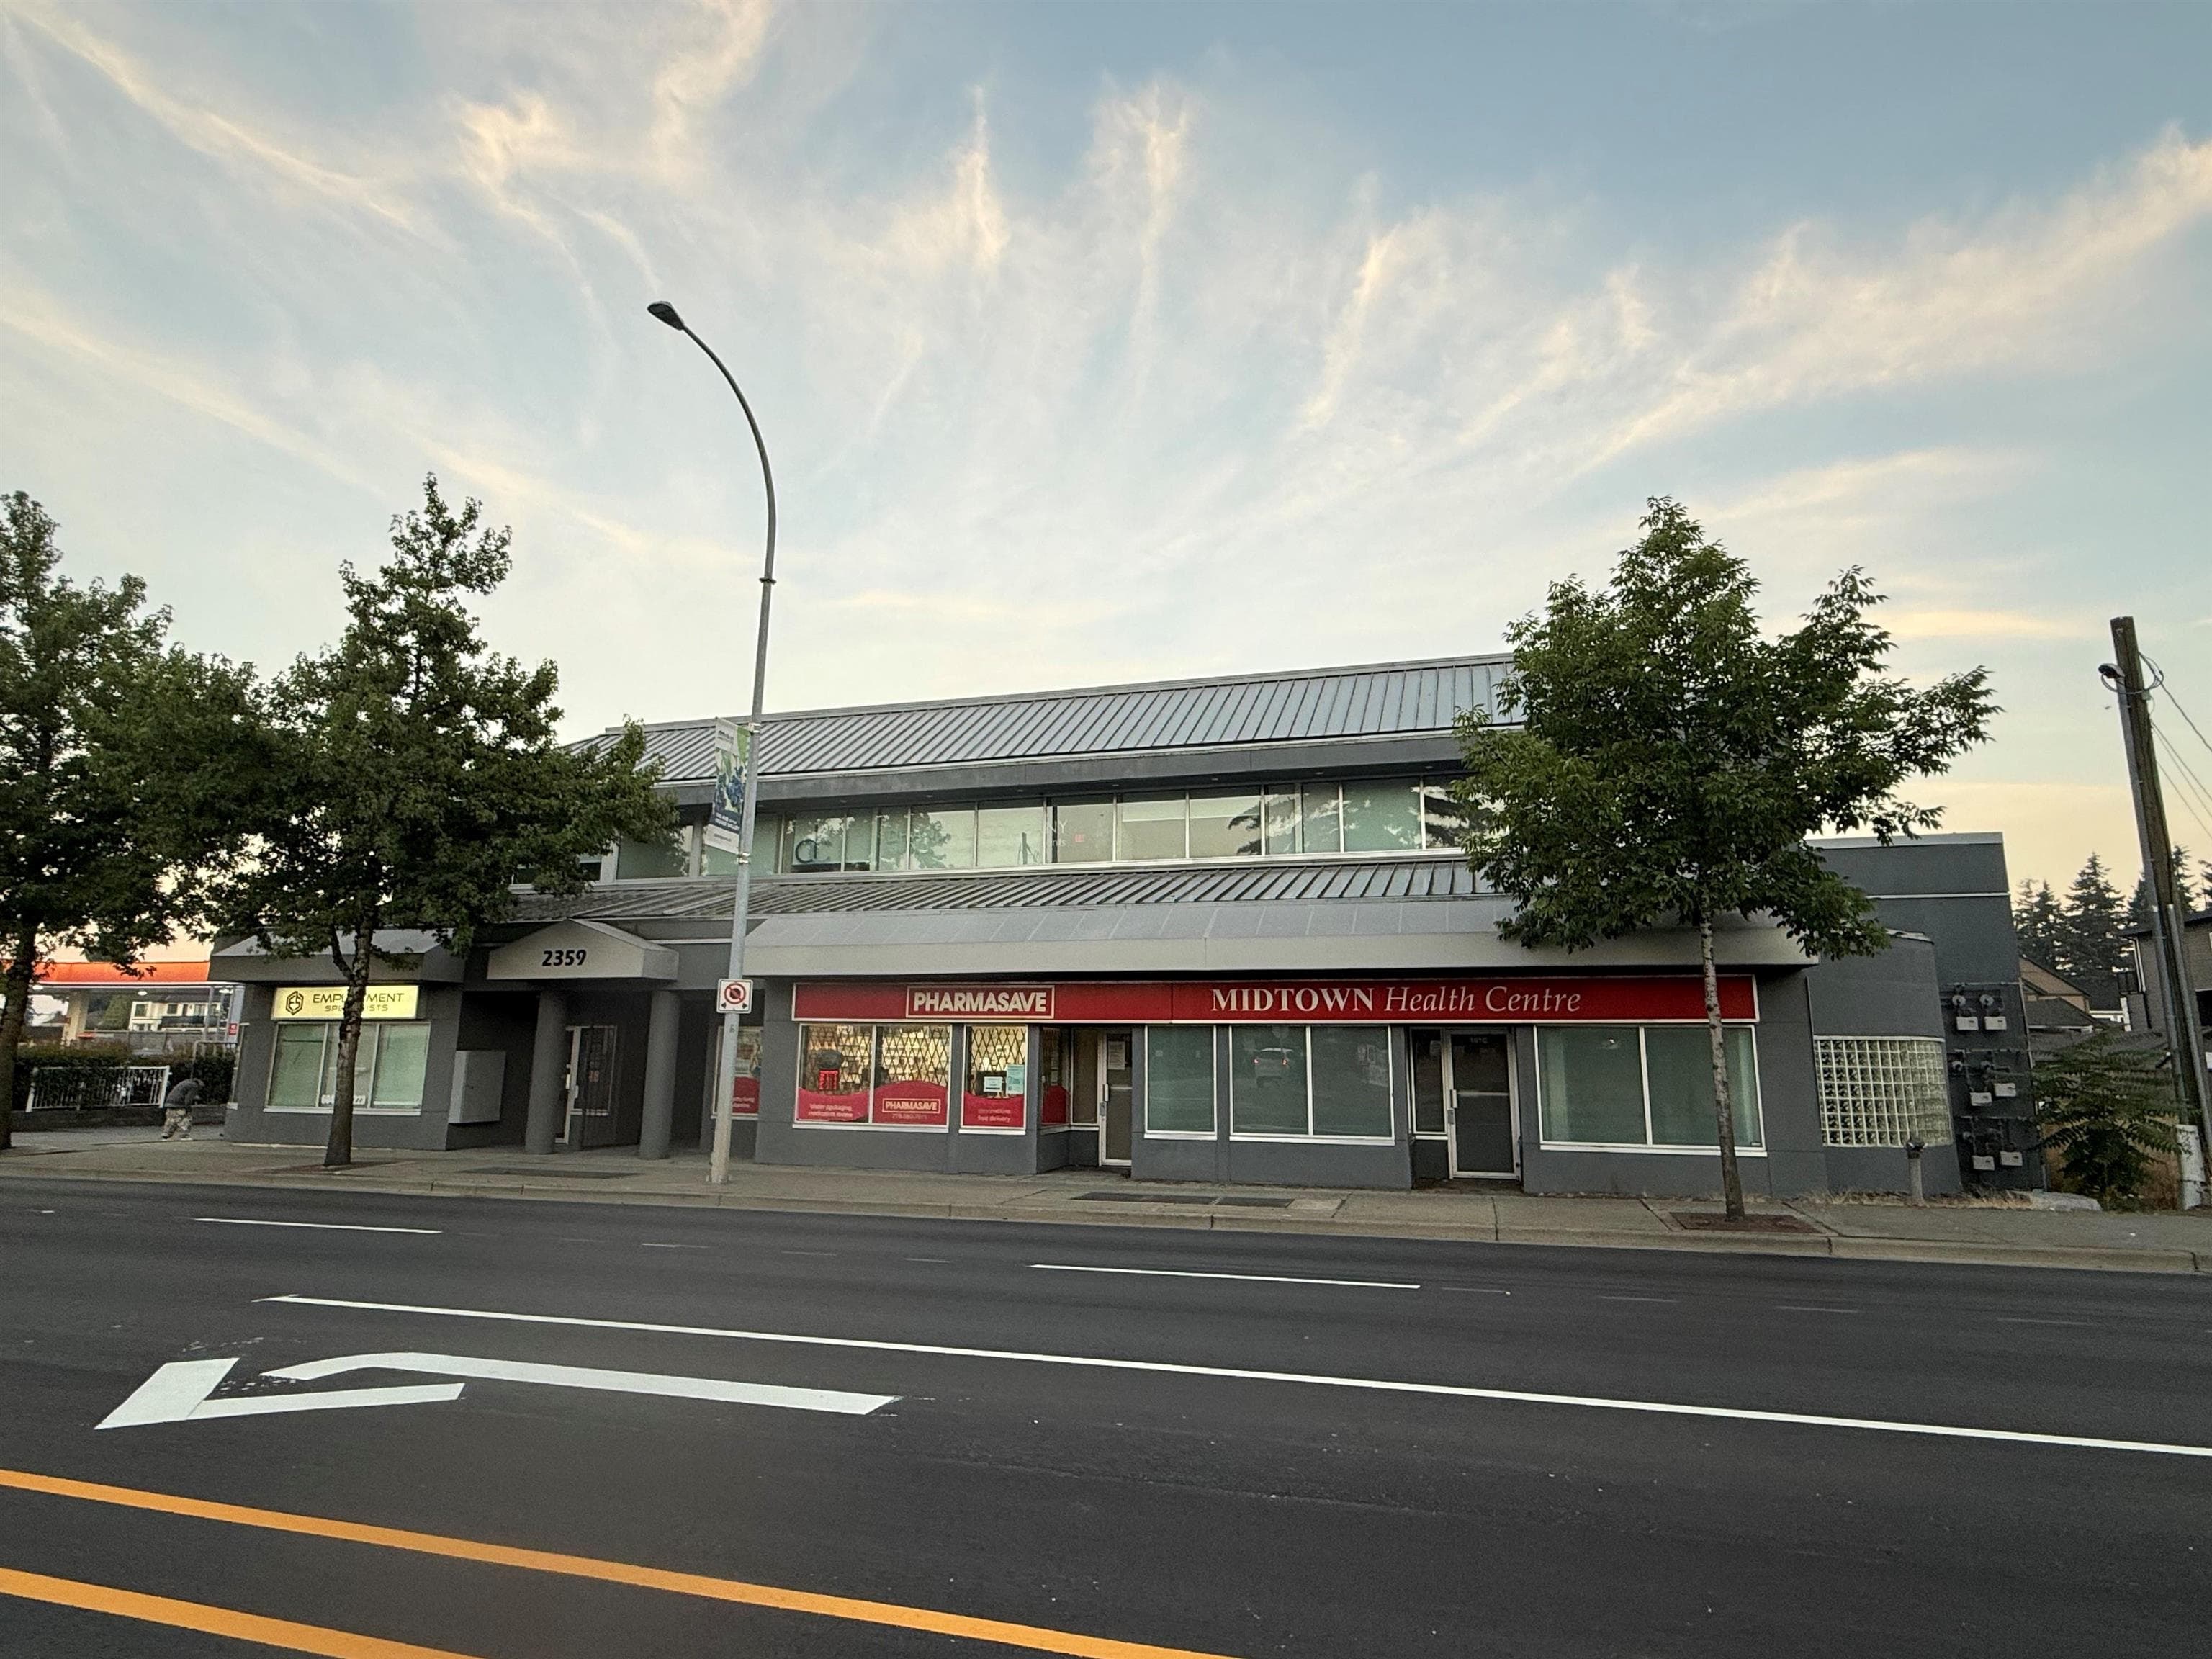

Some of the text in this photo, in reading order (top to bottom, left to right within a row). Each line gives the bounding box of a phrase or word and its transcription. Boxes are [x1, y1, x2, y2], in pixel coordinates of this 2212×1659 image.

[542, 950, 586, 966] 2359
[313, 993, 405, 1003] EMPLMENT
[913, 992, 1047, 1012] PHARMASAVE
[1212, 986, 1581, 1012] MIDTOWN Health Centre
[885, 1100, 938, 1111] PHARMASAVE
